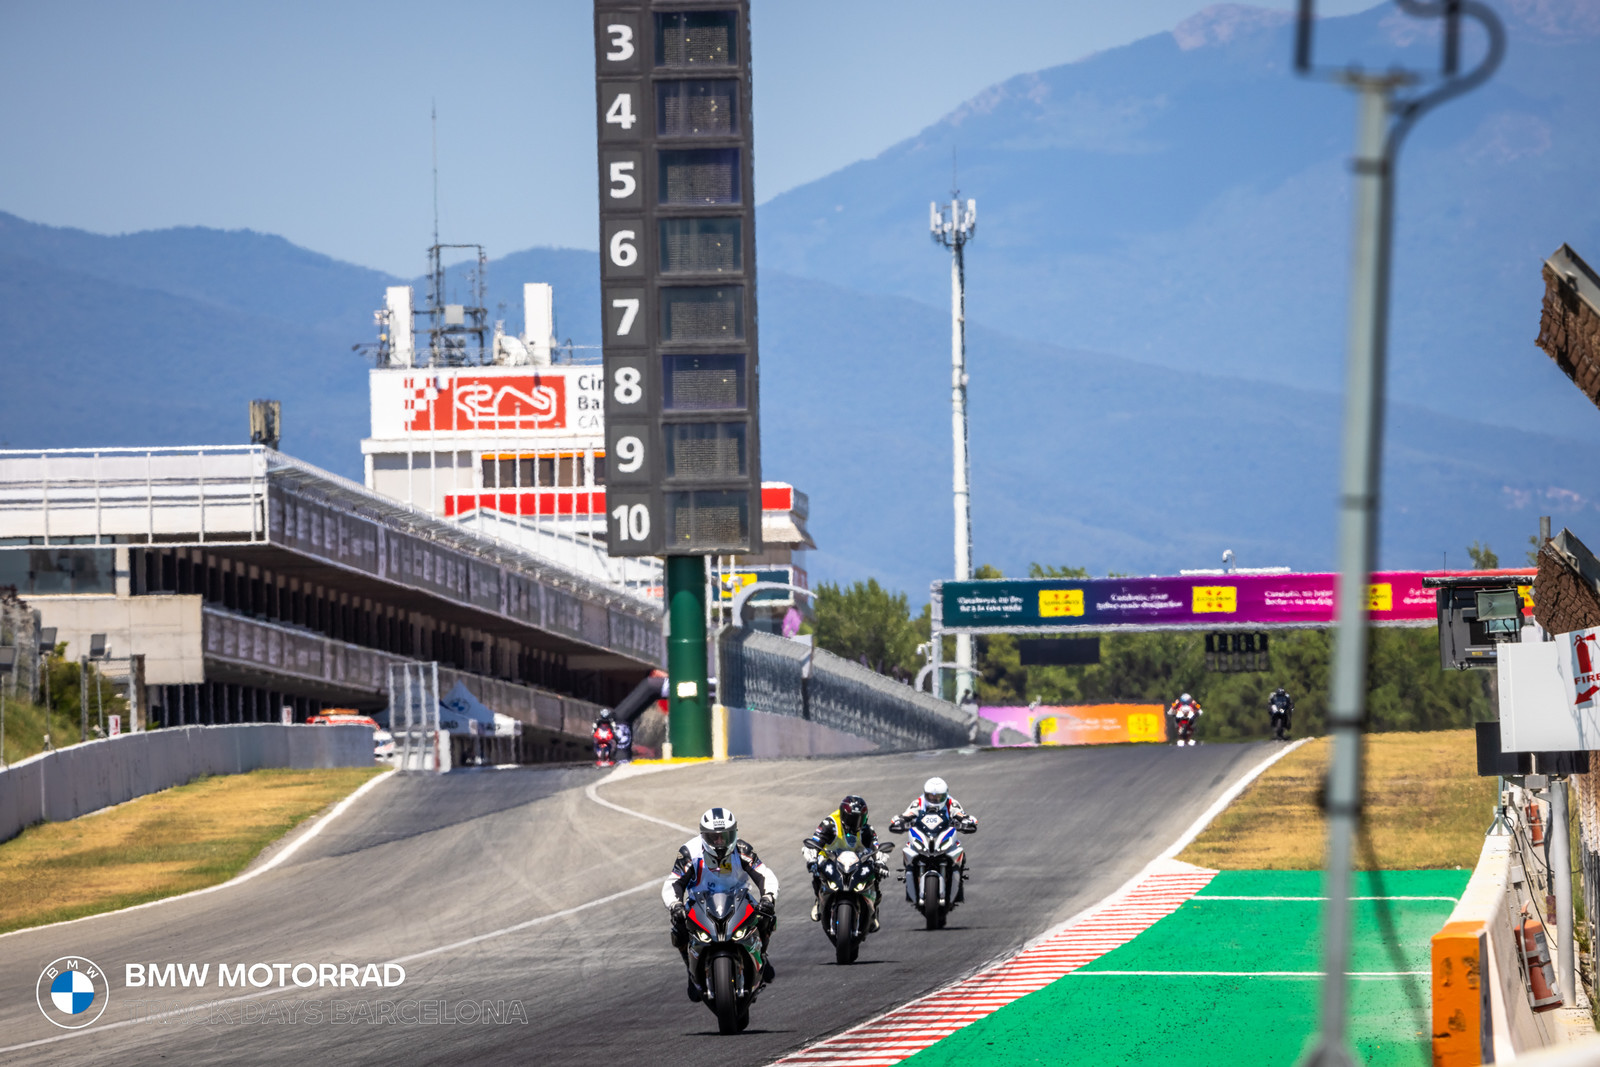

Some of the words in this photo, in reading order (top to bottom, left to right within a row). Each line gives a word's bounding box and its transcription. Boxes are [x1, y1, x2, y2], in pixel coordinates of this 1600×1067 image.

[607, 24, 635, 61] 3
[606, 93, 637, 130] 4
[609, 161, 636, 199] 5
[610, 229, 638, 267] 6
[612, 298, 640, 336] 7
[613, 366, 642, 405] 8
[615, 435, 645, 473] 9
[611, 503, 651, 541] 10
[1574, 673, 1600, 685] FIRE
